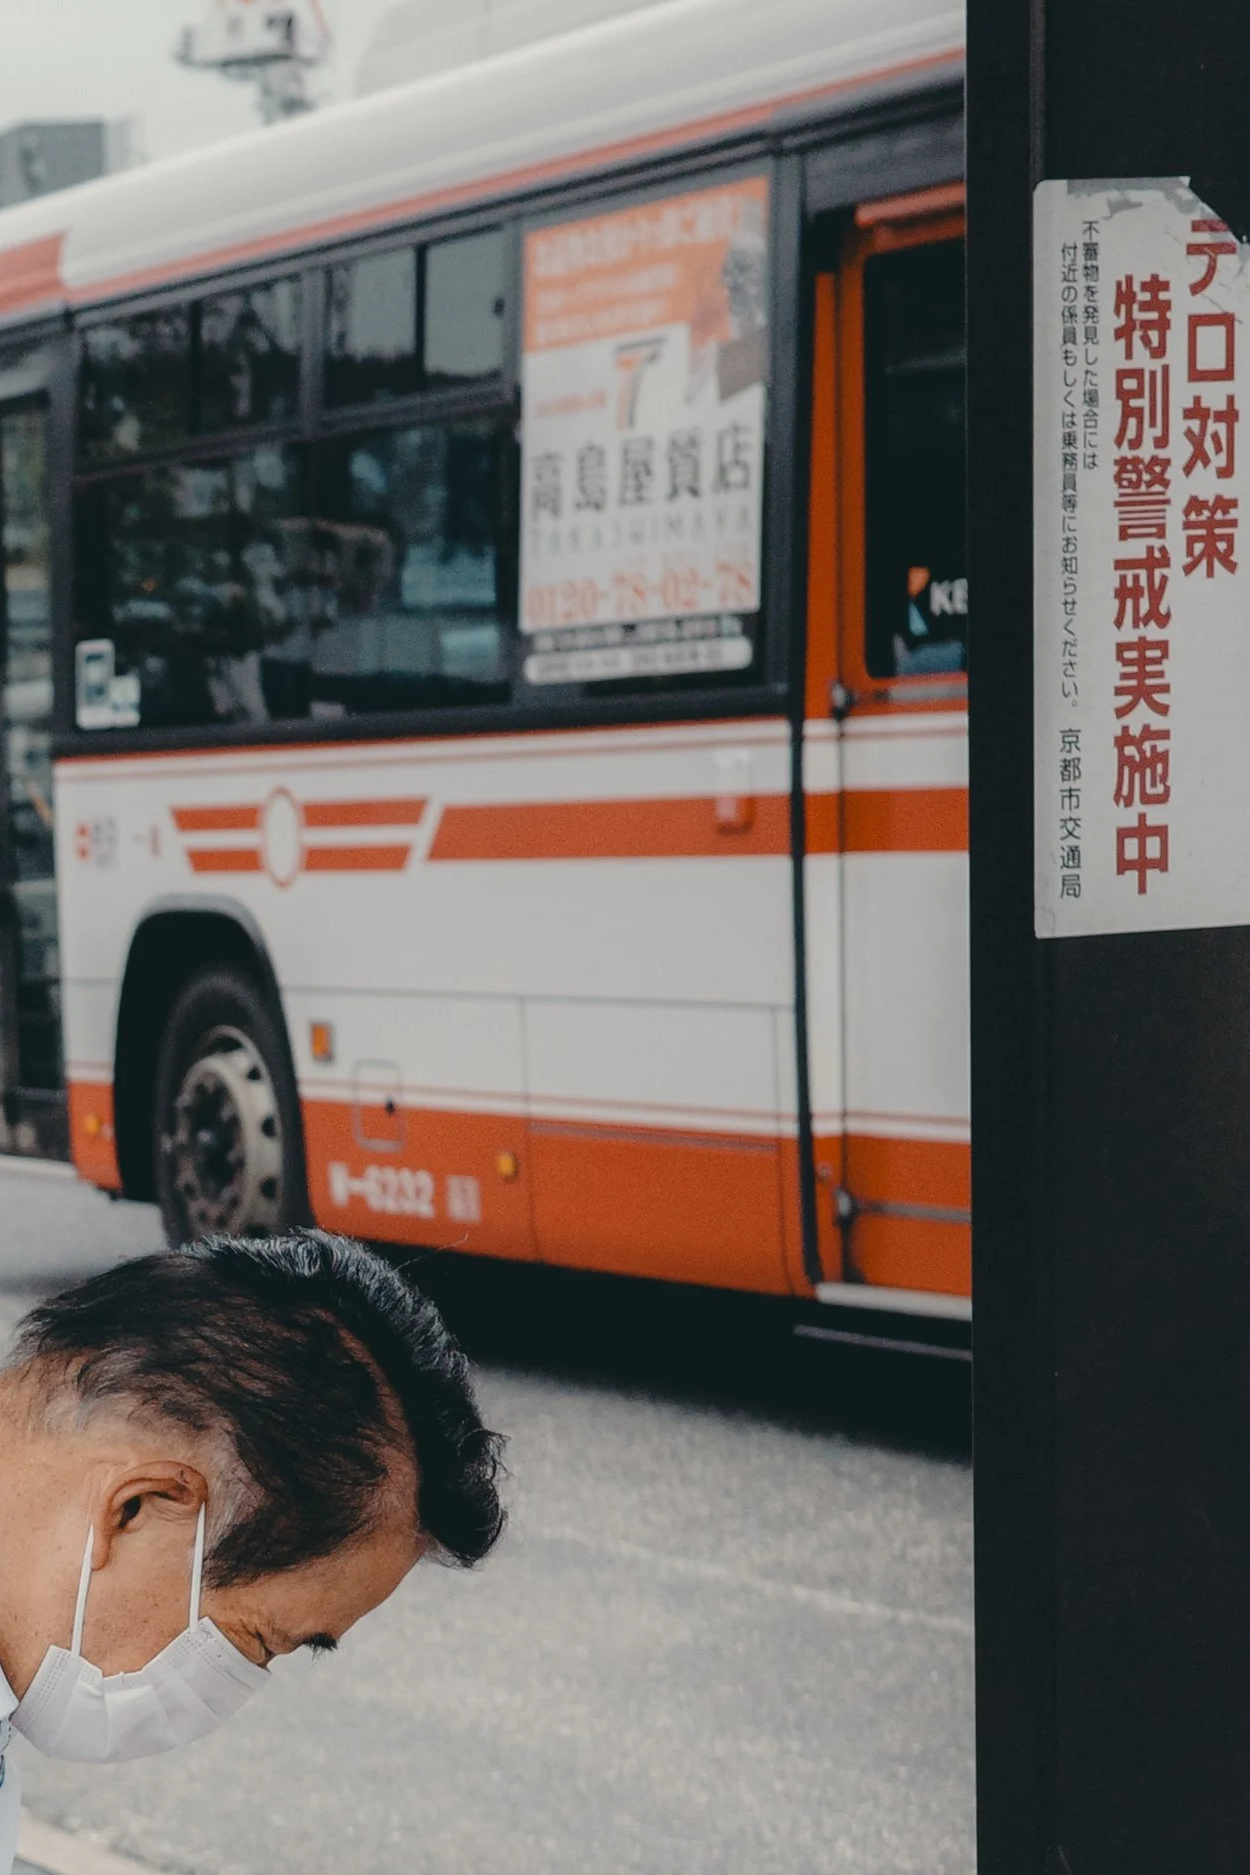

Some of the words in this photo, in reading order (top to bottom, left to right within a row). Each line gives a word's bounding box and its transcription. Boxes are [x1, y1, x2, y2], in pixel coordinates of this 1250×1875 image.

[1082, 221, 1099, 470] 不審物を発見した場合には
[1182, 219, 1239, 579] テロ対策
[1113, 273, 1171, 895] 特別警戒実施中
[1059, 727, 1082, 899] 京都市交通局
